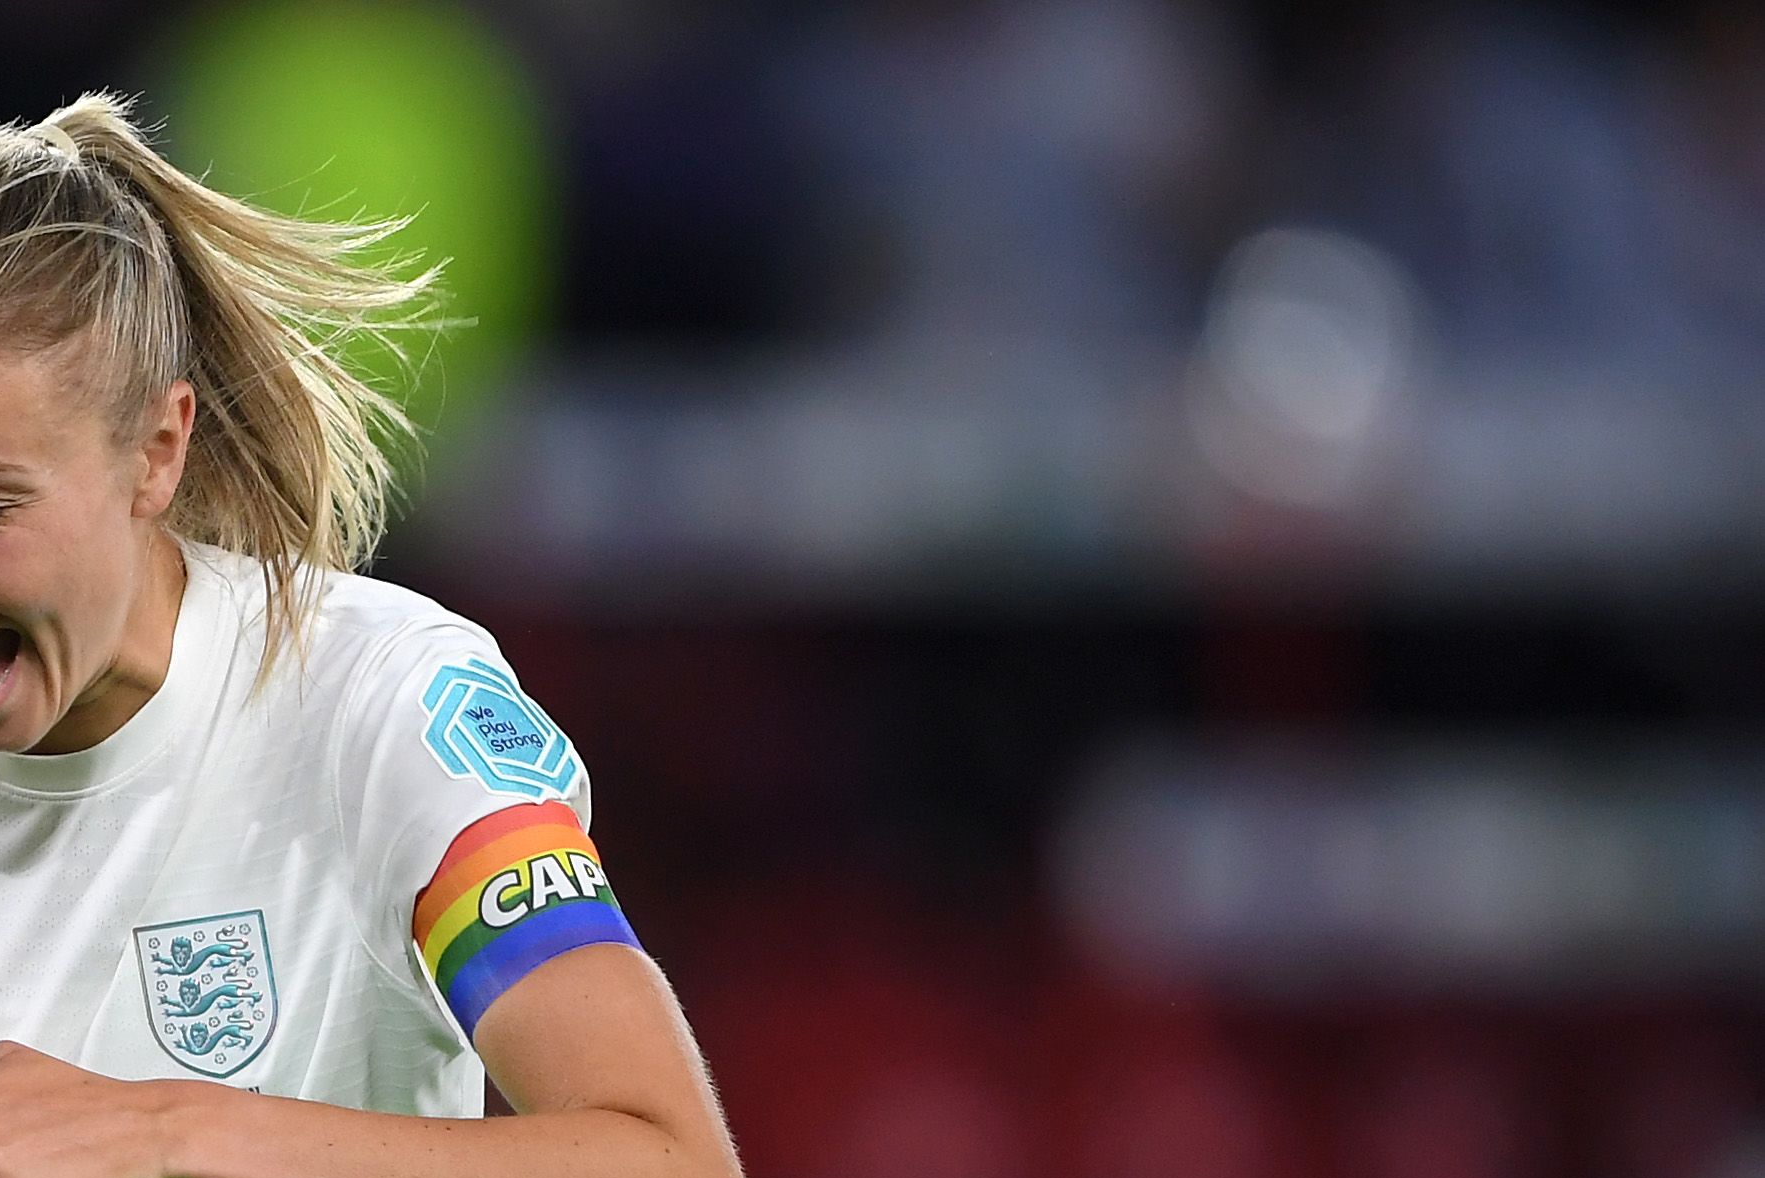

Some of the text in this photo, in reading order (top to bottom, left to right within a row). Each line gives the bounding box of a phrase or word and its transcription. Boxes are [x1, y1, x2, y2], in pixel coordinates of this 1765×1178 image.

[465, 706, 494, 720] We
[490, 734, 543, 752] Strong
[479, 851, 607, 929] CAP
